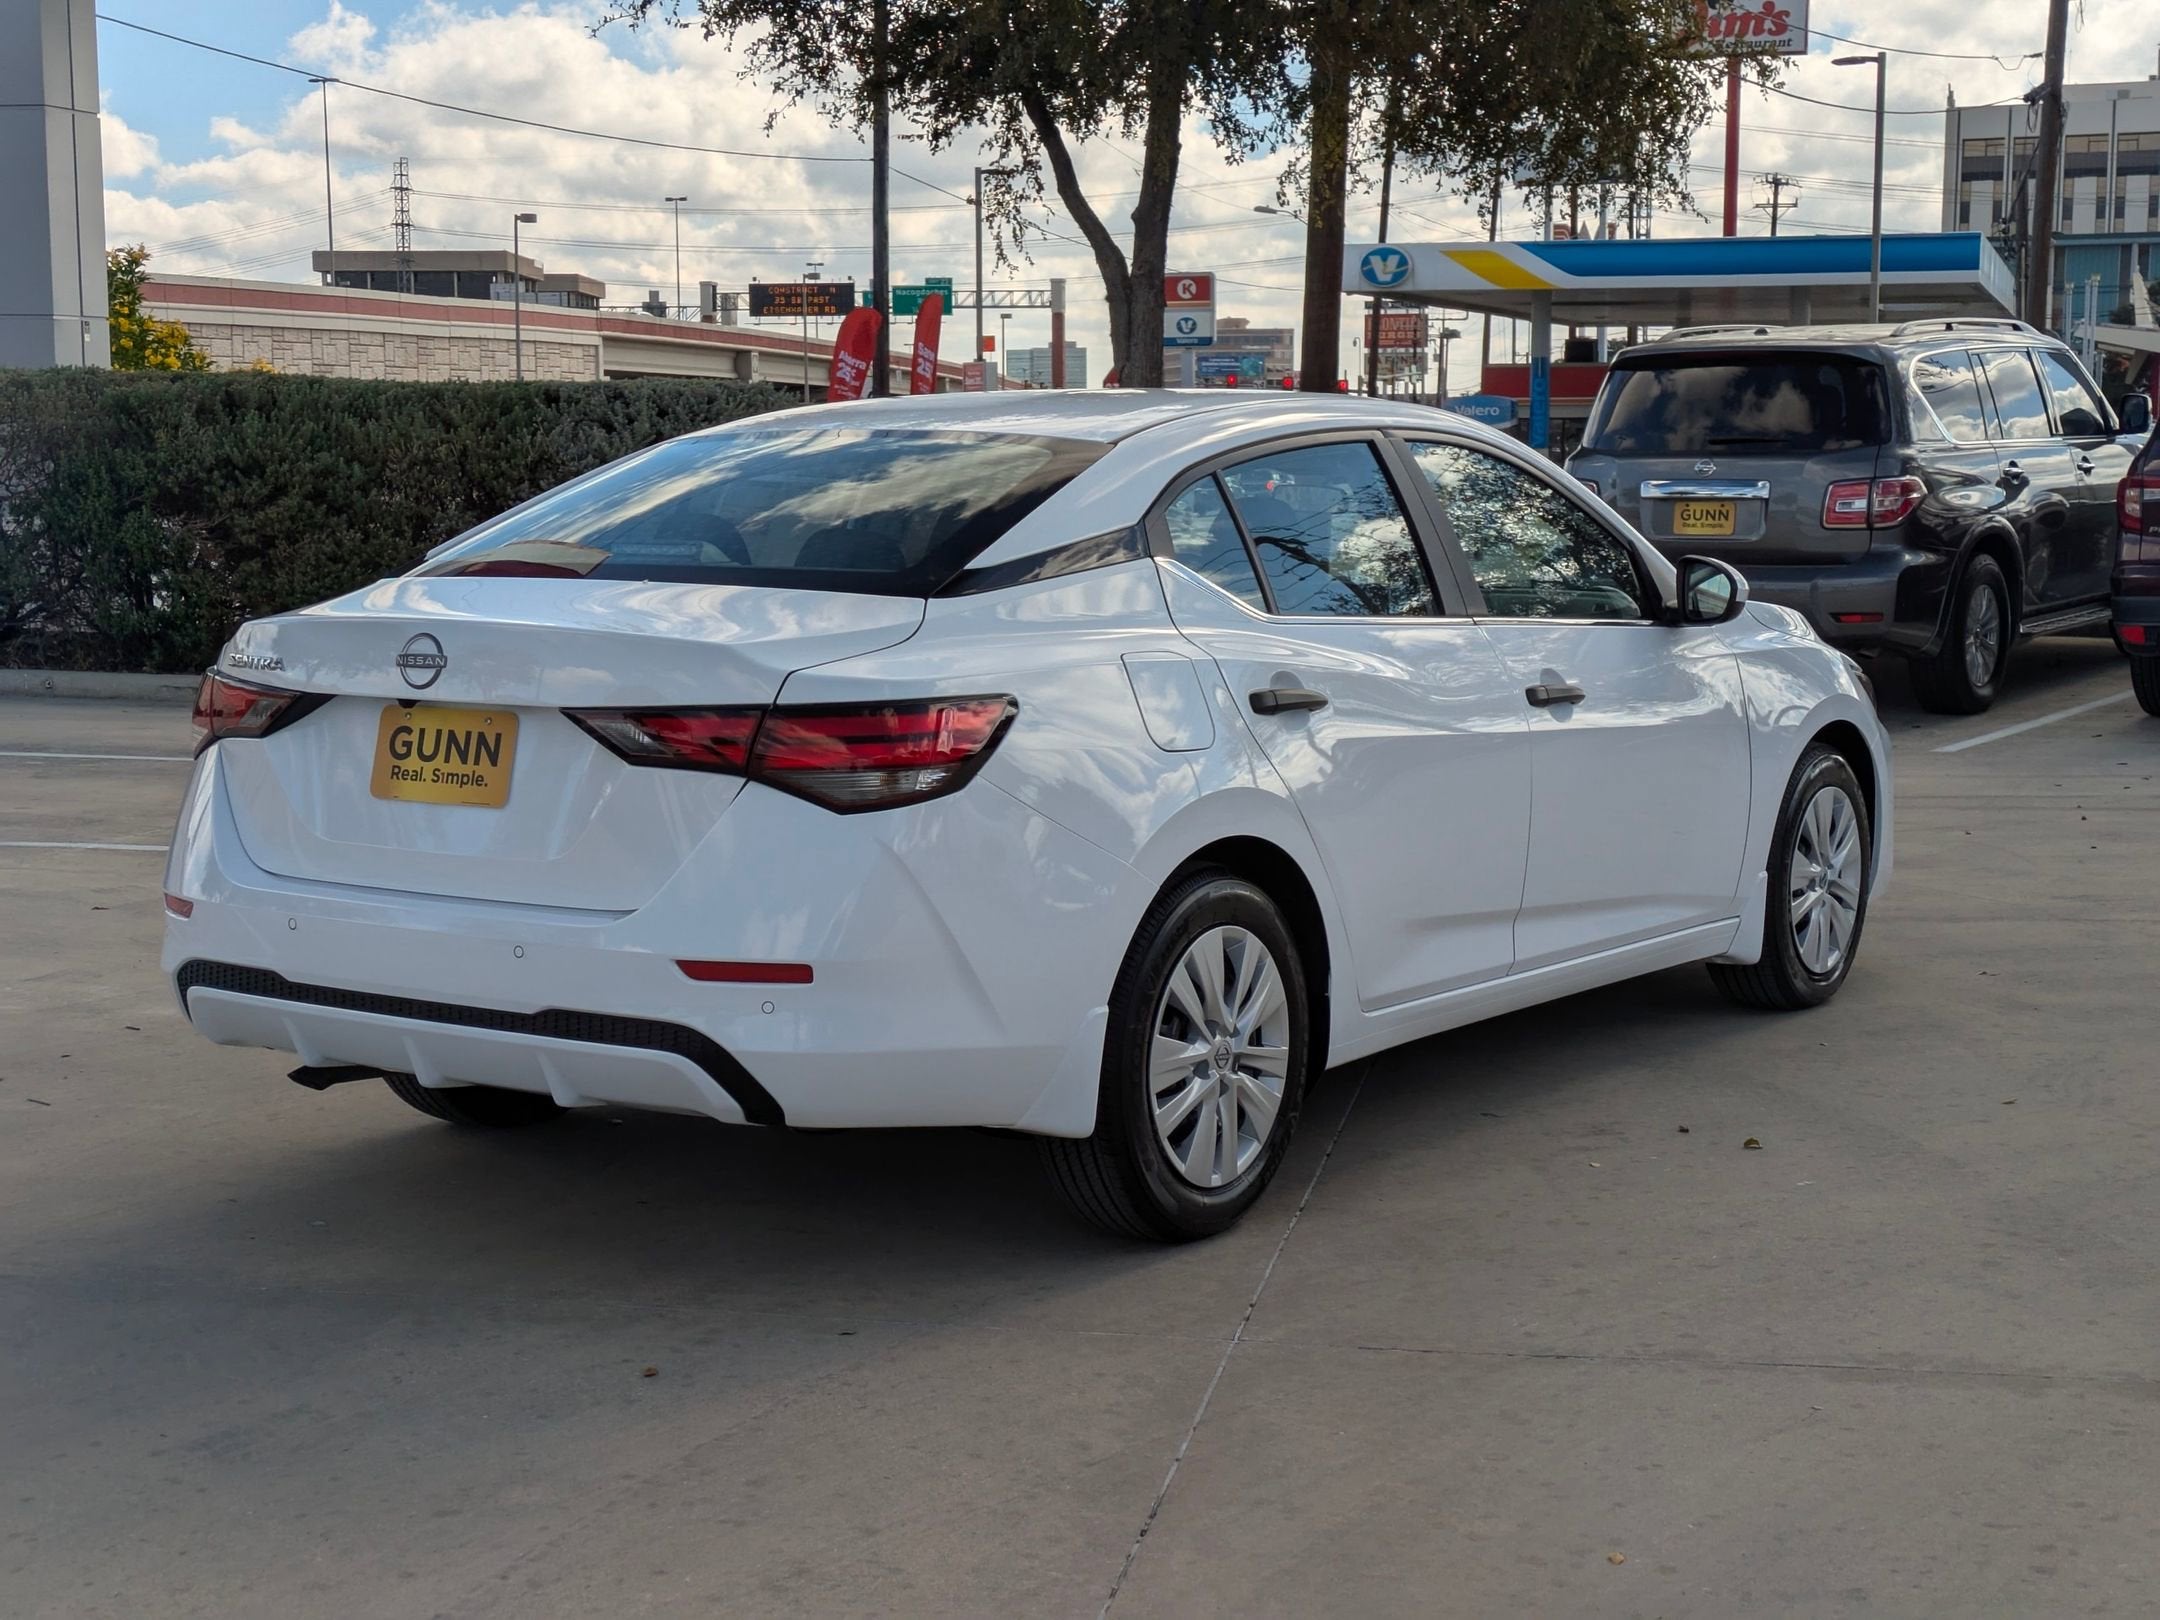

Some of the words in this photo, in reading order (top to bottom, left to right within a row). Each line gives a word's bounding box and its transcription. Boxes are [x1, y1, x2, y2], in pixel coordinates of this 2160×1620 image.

[763, 306, 819, 314] EISENHAER
[1455, 405, 1500, 416] Valero
[1680, 508, 1729, 521] GUNN
[228, 653, 286, 671] SENTRA
[396, 655, 445, 666] NISSAN
[389, 725, 502, 767] GUNN
[391, 765, 426, 782] Real.
